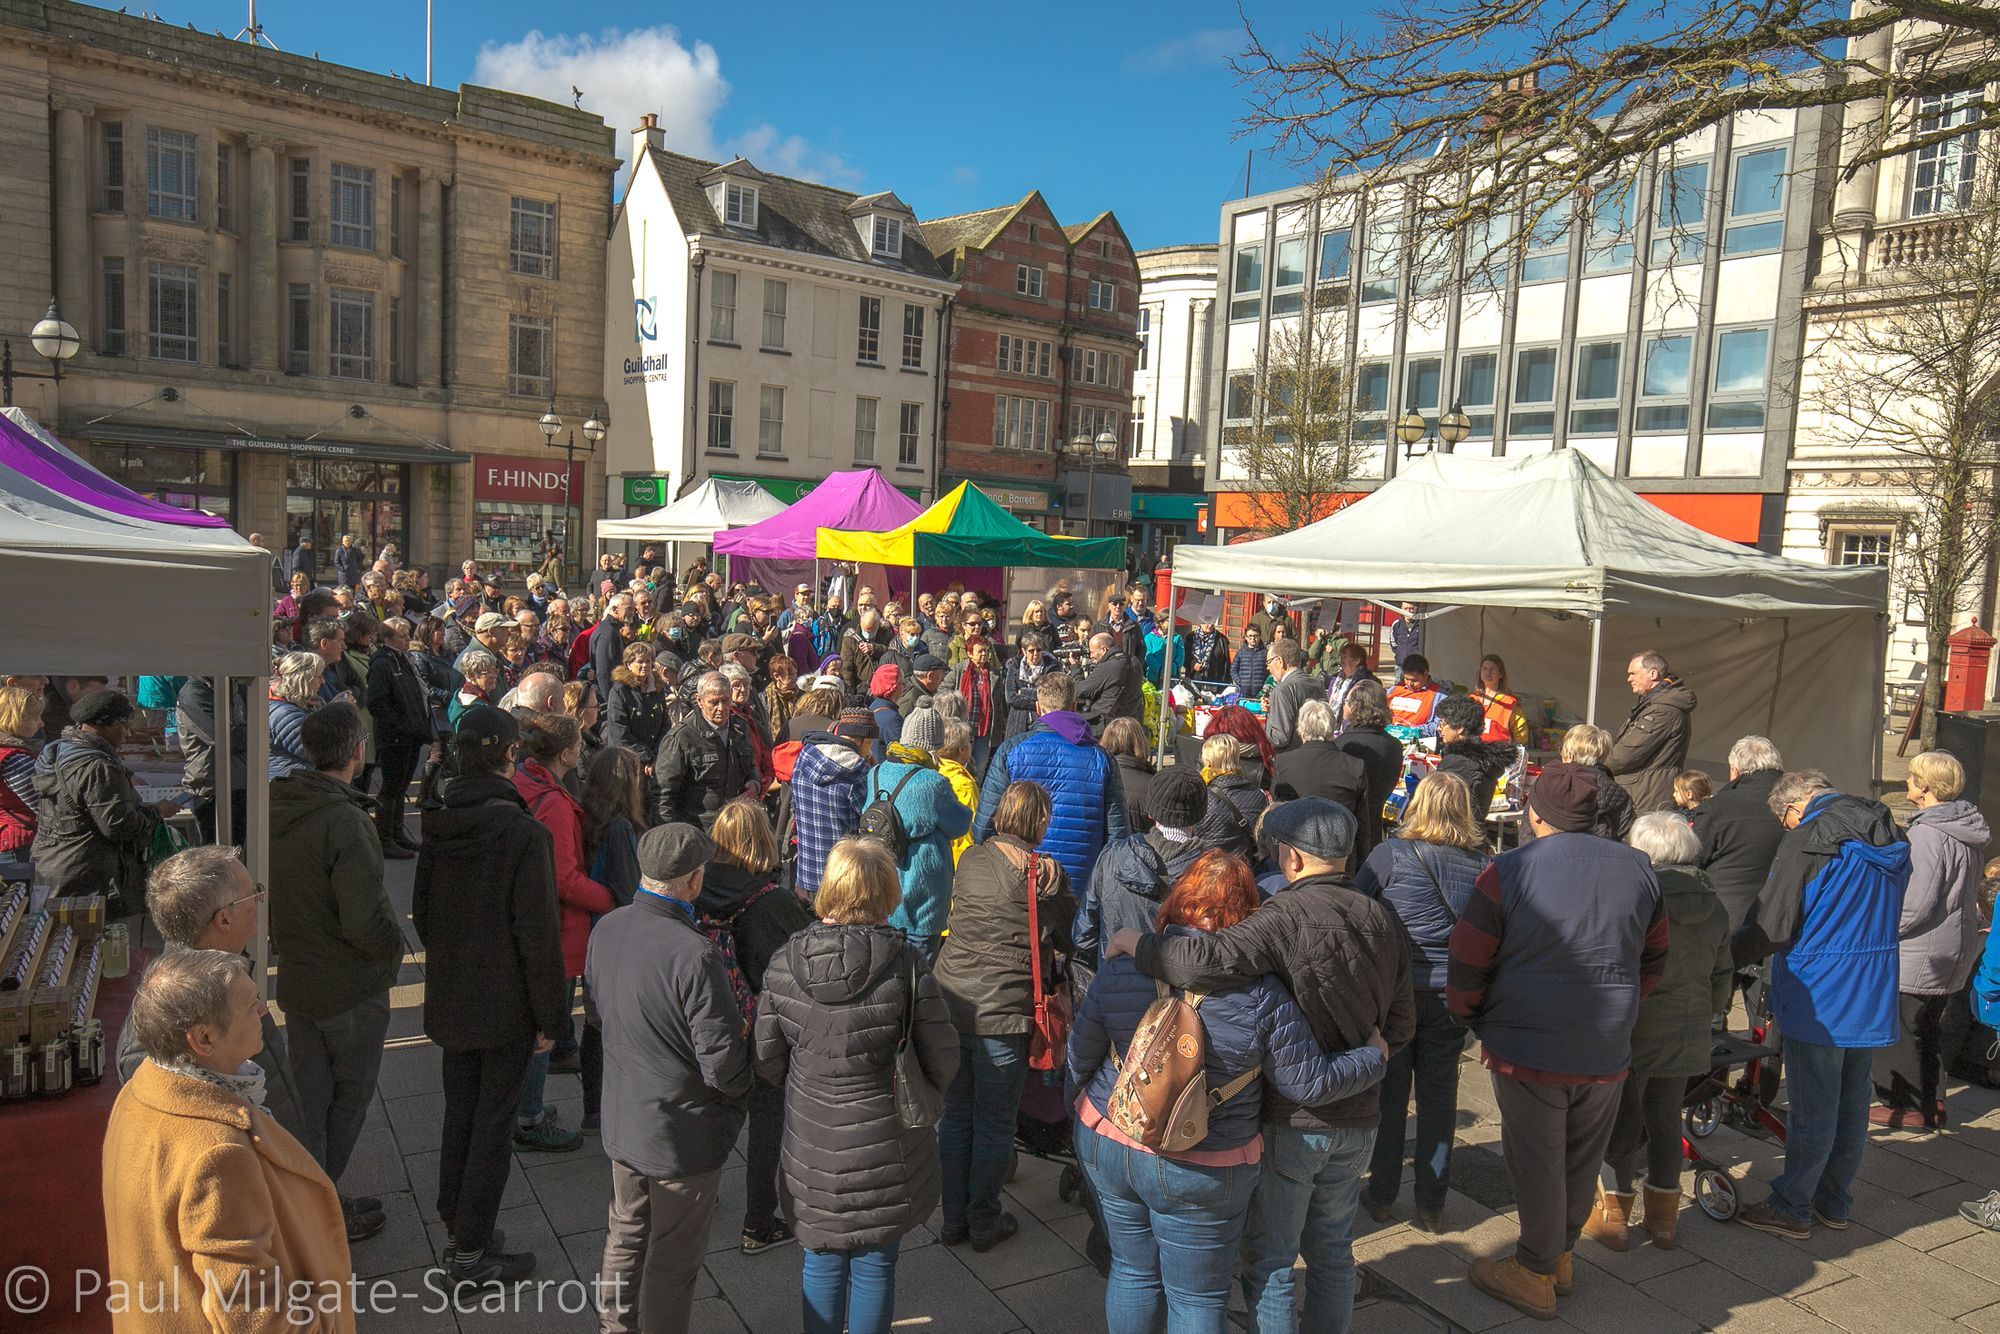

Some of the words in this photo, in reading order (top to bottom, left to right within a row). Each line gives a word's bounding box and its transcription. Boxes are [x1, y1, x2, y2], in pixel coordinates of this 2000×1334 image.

[623, 353, 668, 375] Guildhall
[623, 375, 648, 385] SHOPPING
[648, 372, 667, 383] CENTRE
[231, 439, 246, 447] THE
[247, 440, 289, 450] GUILDHALL
[290, 443, 327, 453] SHOPPING
[327, 446, 354, 455] CENTRE
[487, 467, 570, 492] F.HINDS
[1008, 493, 1035, 505] Barrett
